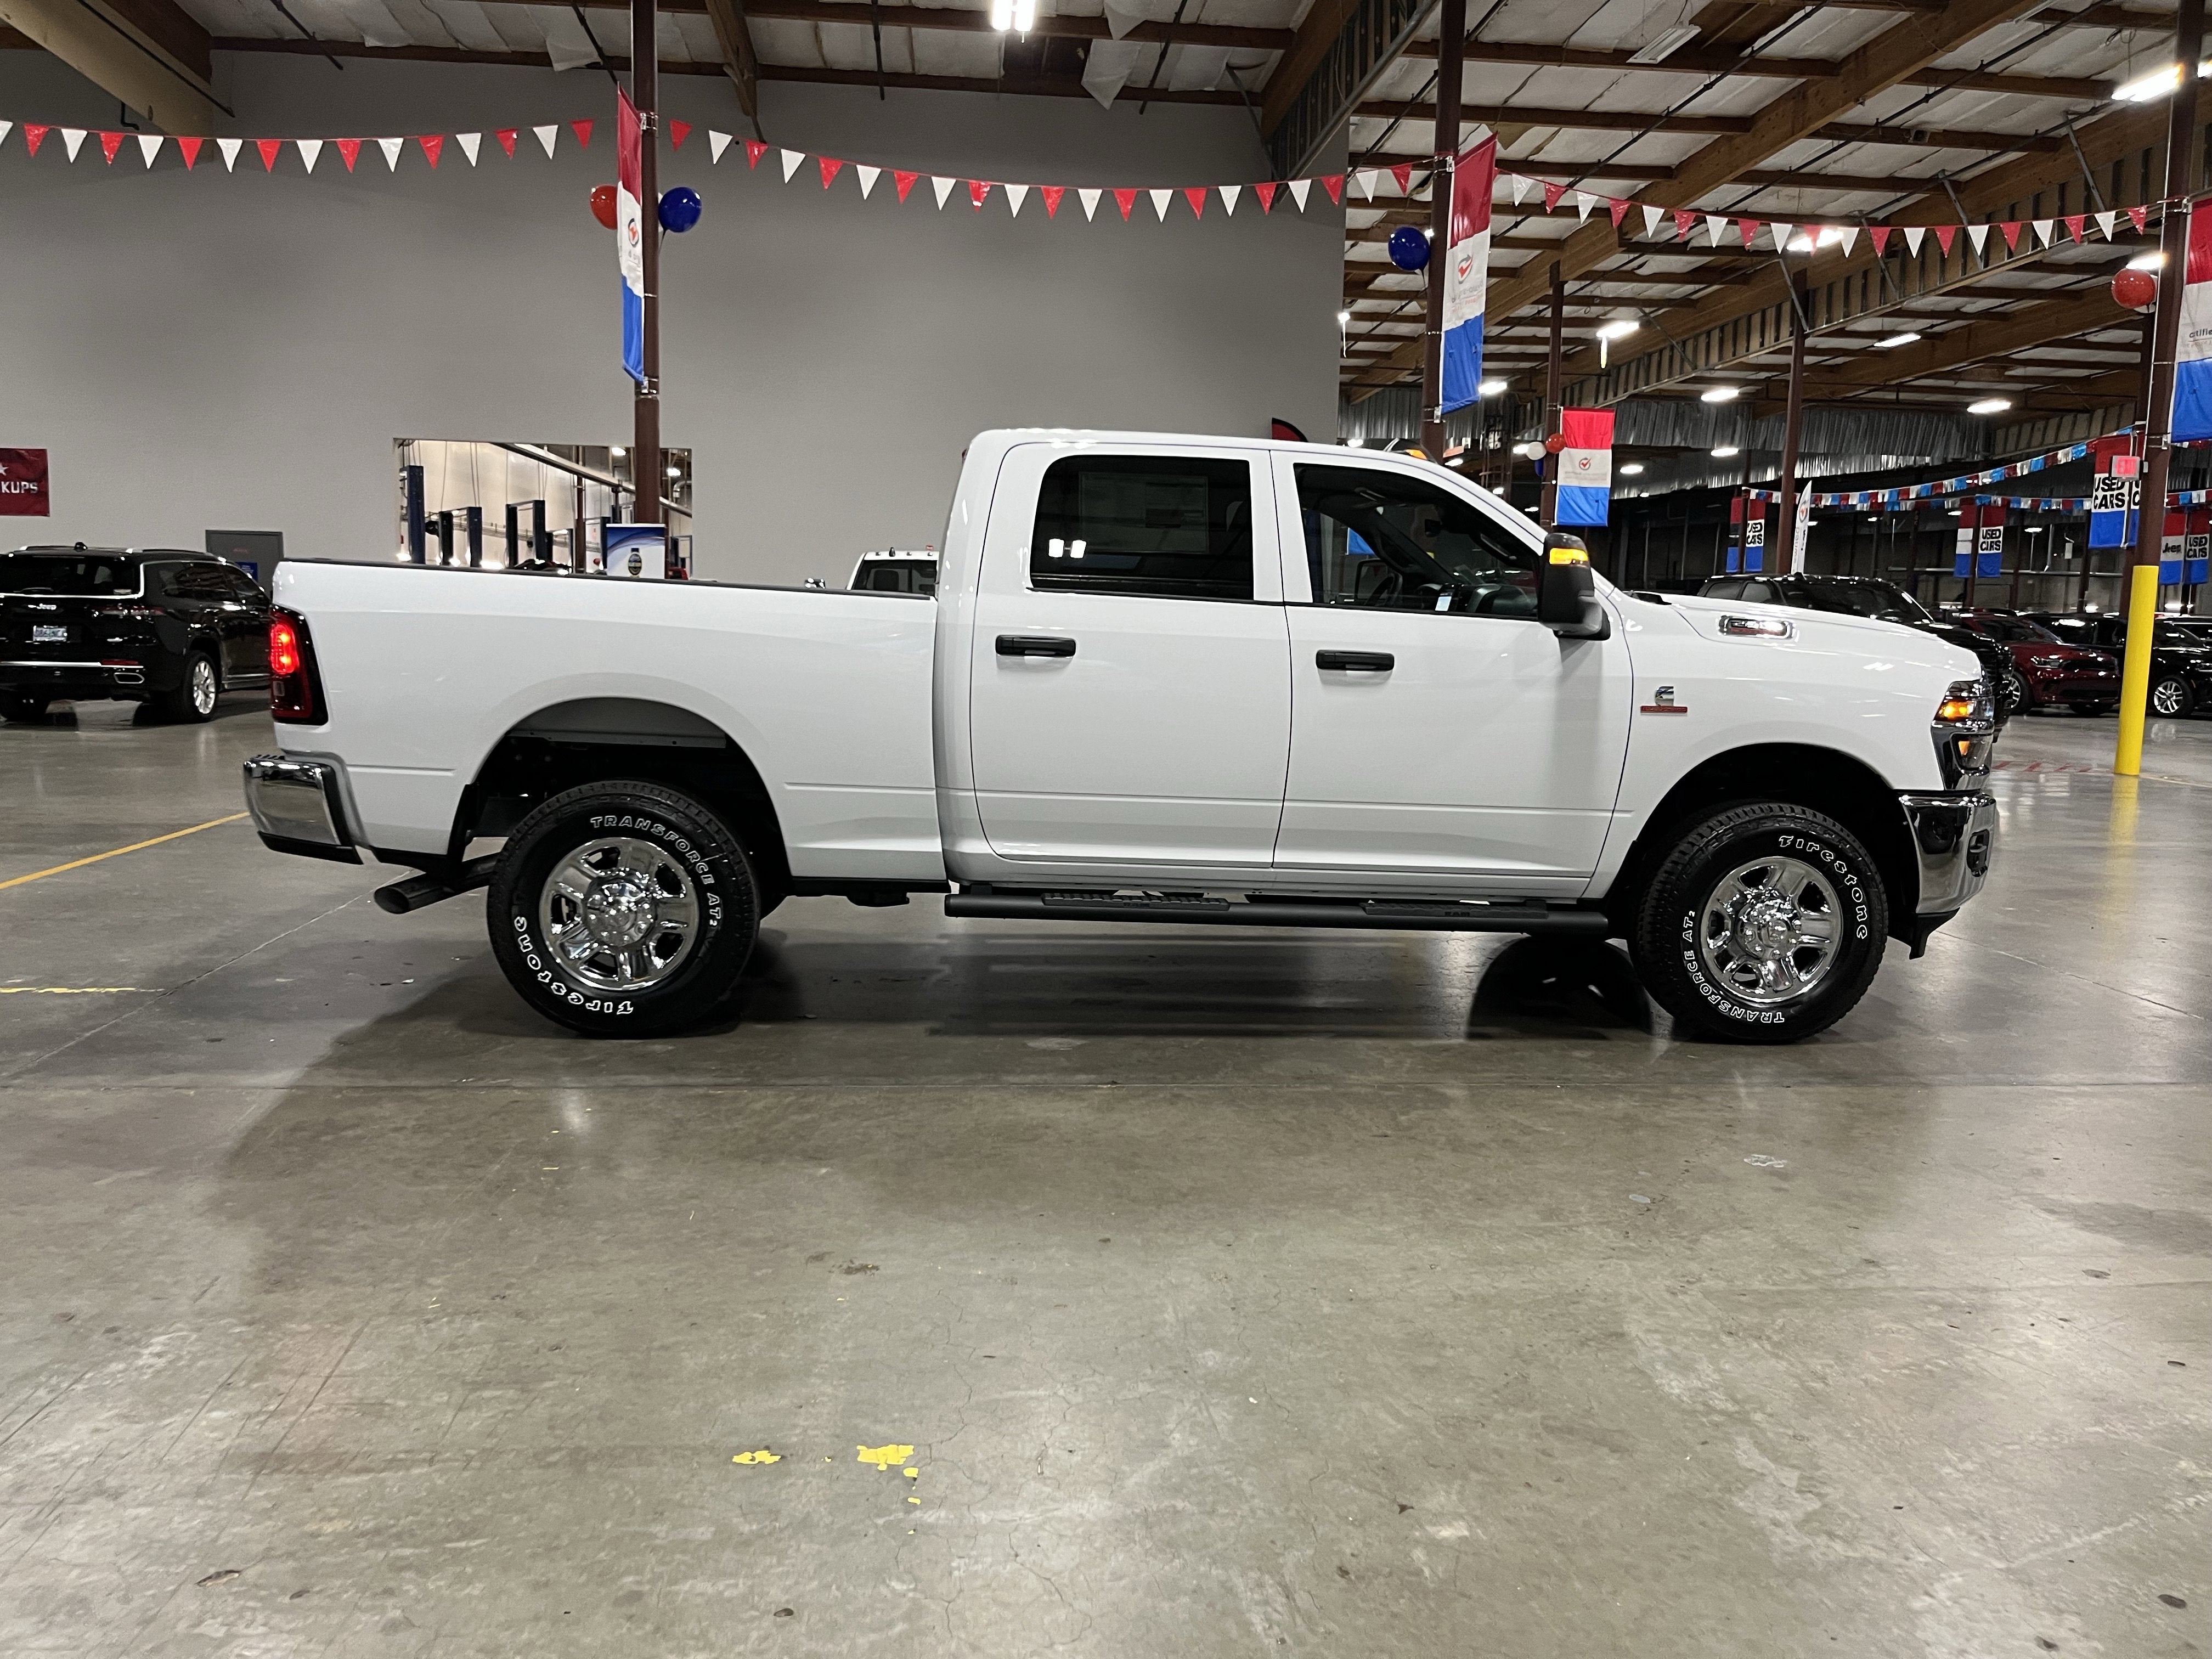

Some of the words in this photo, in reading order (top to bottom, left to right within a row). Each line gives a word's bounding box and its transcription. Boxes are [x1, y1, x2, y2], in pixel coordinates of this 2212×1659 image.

[1, 481, 38, 493] KUPS
[2094, 492, 2125, 509] CARS
[1982, 529, 2001, 539] USED
[590, 815, 715, 885] TRANSFORCE
[1684, 950, 1785, 1023] TRANSFORCE
